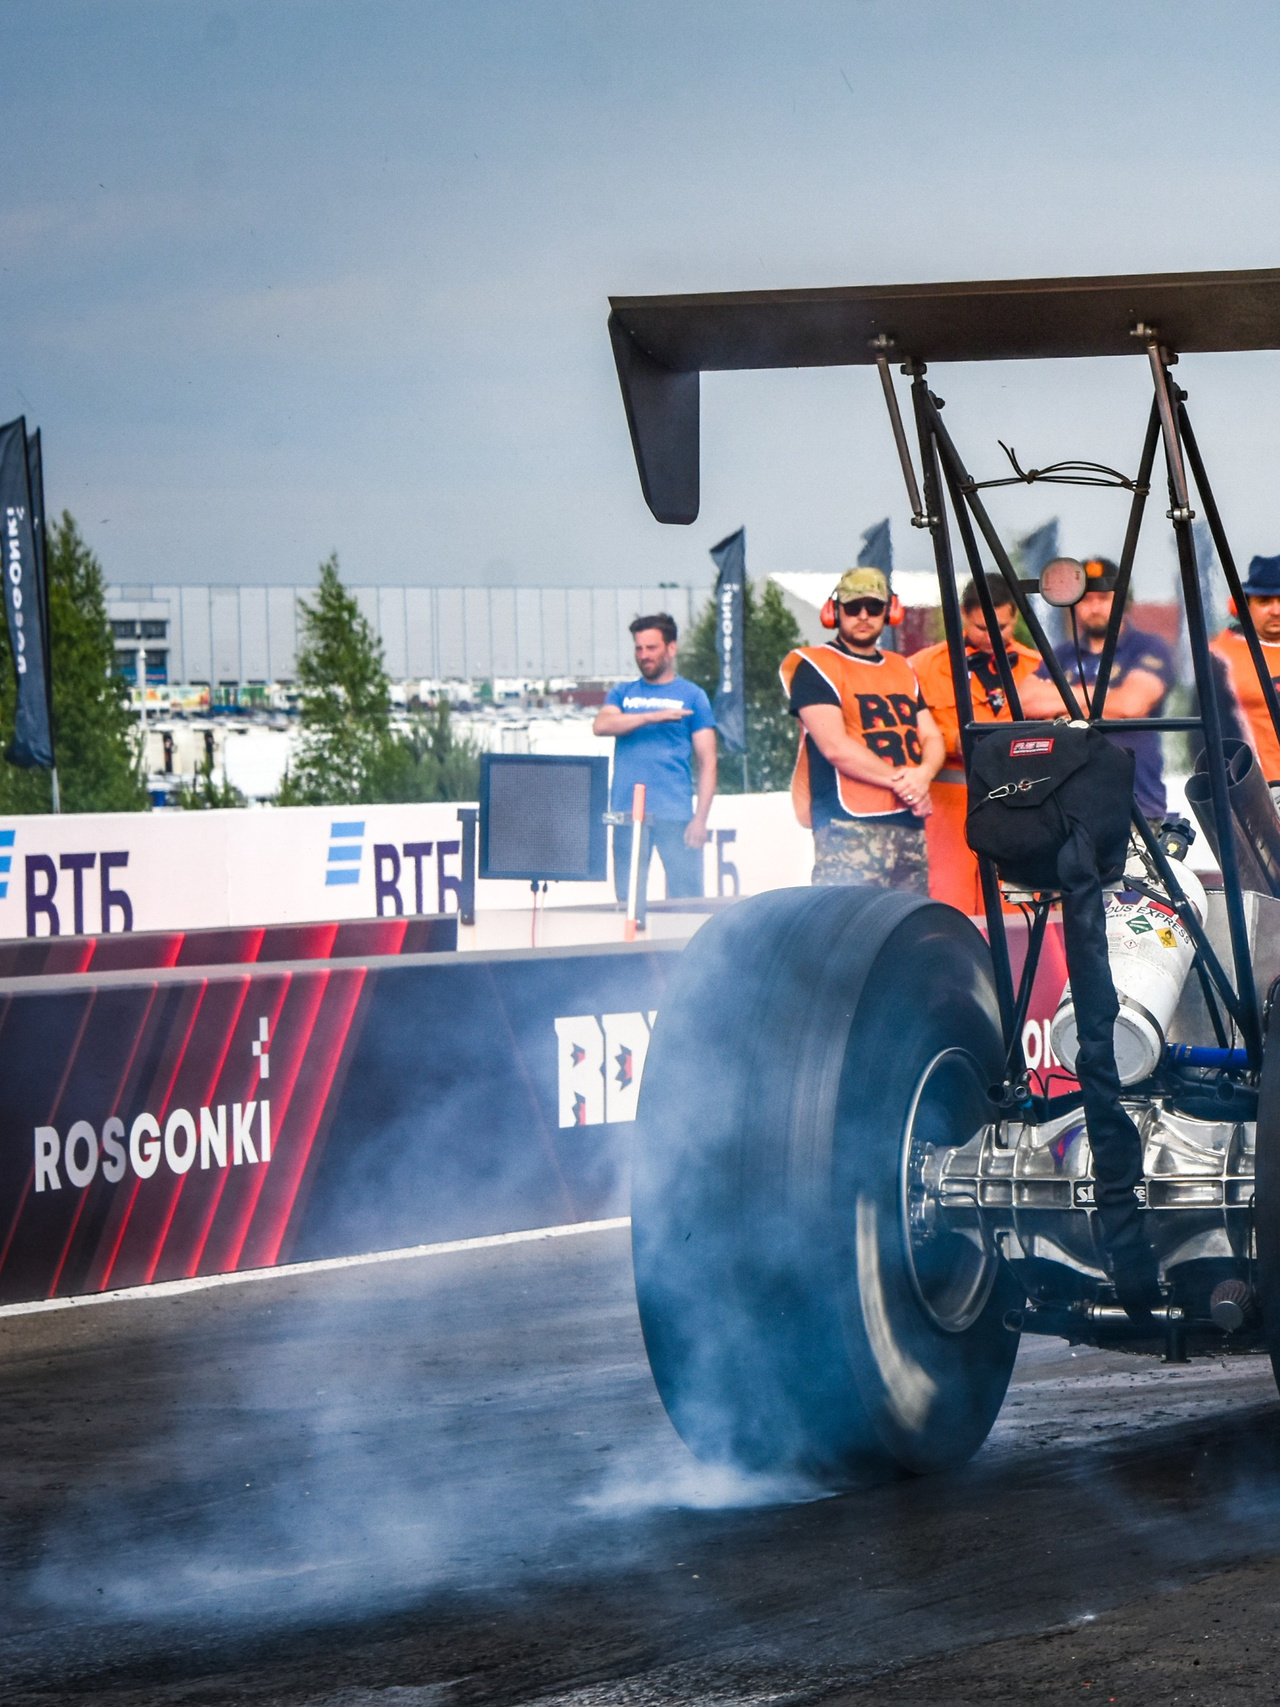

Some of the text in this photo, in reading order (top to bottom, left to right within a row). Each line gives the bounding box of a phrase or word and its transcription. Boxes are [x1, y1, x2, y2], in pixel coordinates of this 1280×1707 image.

[854, 693, 918, 730] RD
[25, 851, 133, 937] ВТБ
[1137, 906, 1190, 945] EXPRESS
[554, 1010, 657, 1128] RD
[34, 1100, 271, 1192] ROSGONKI
